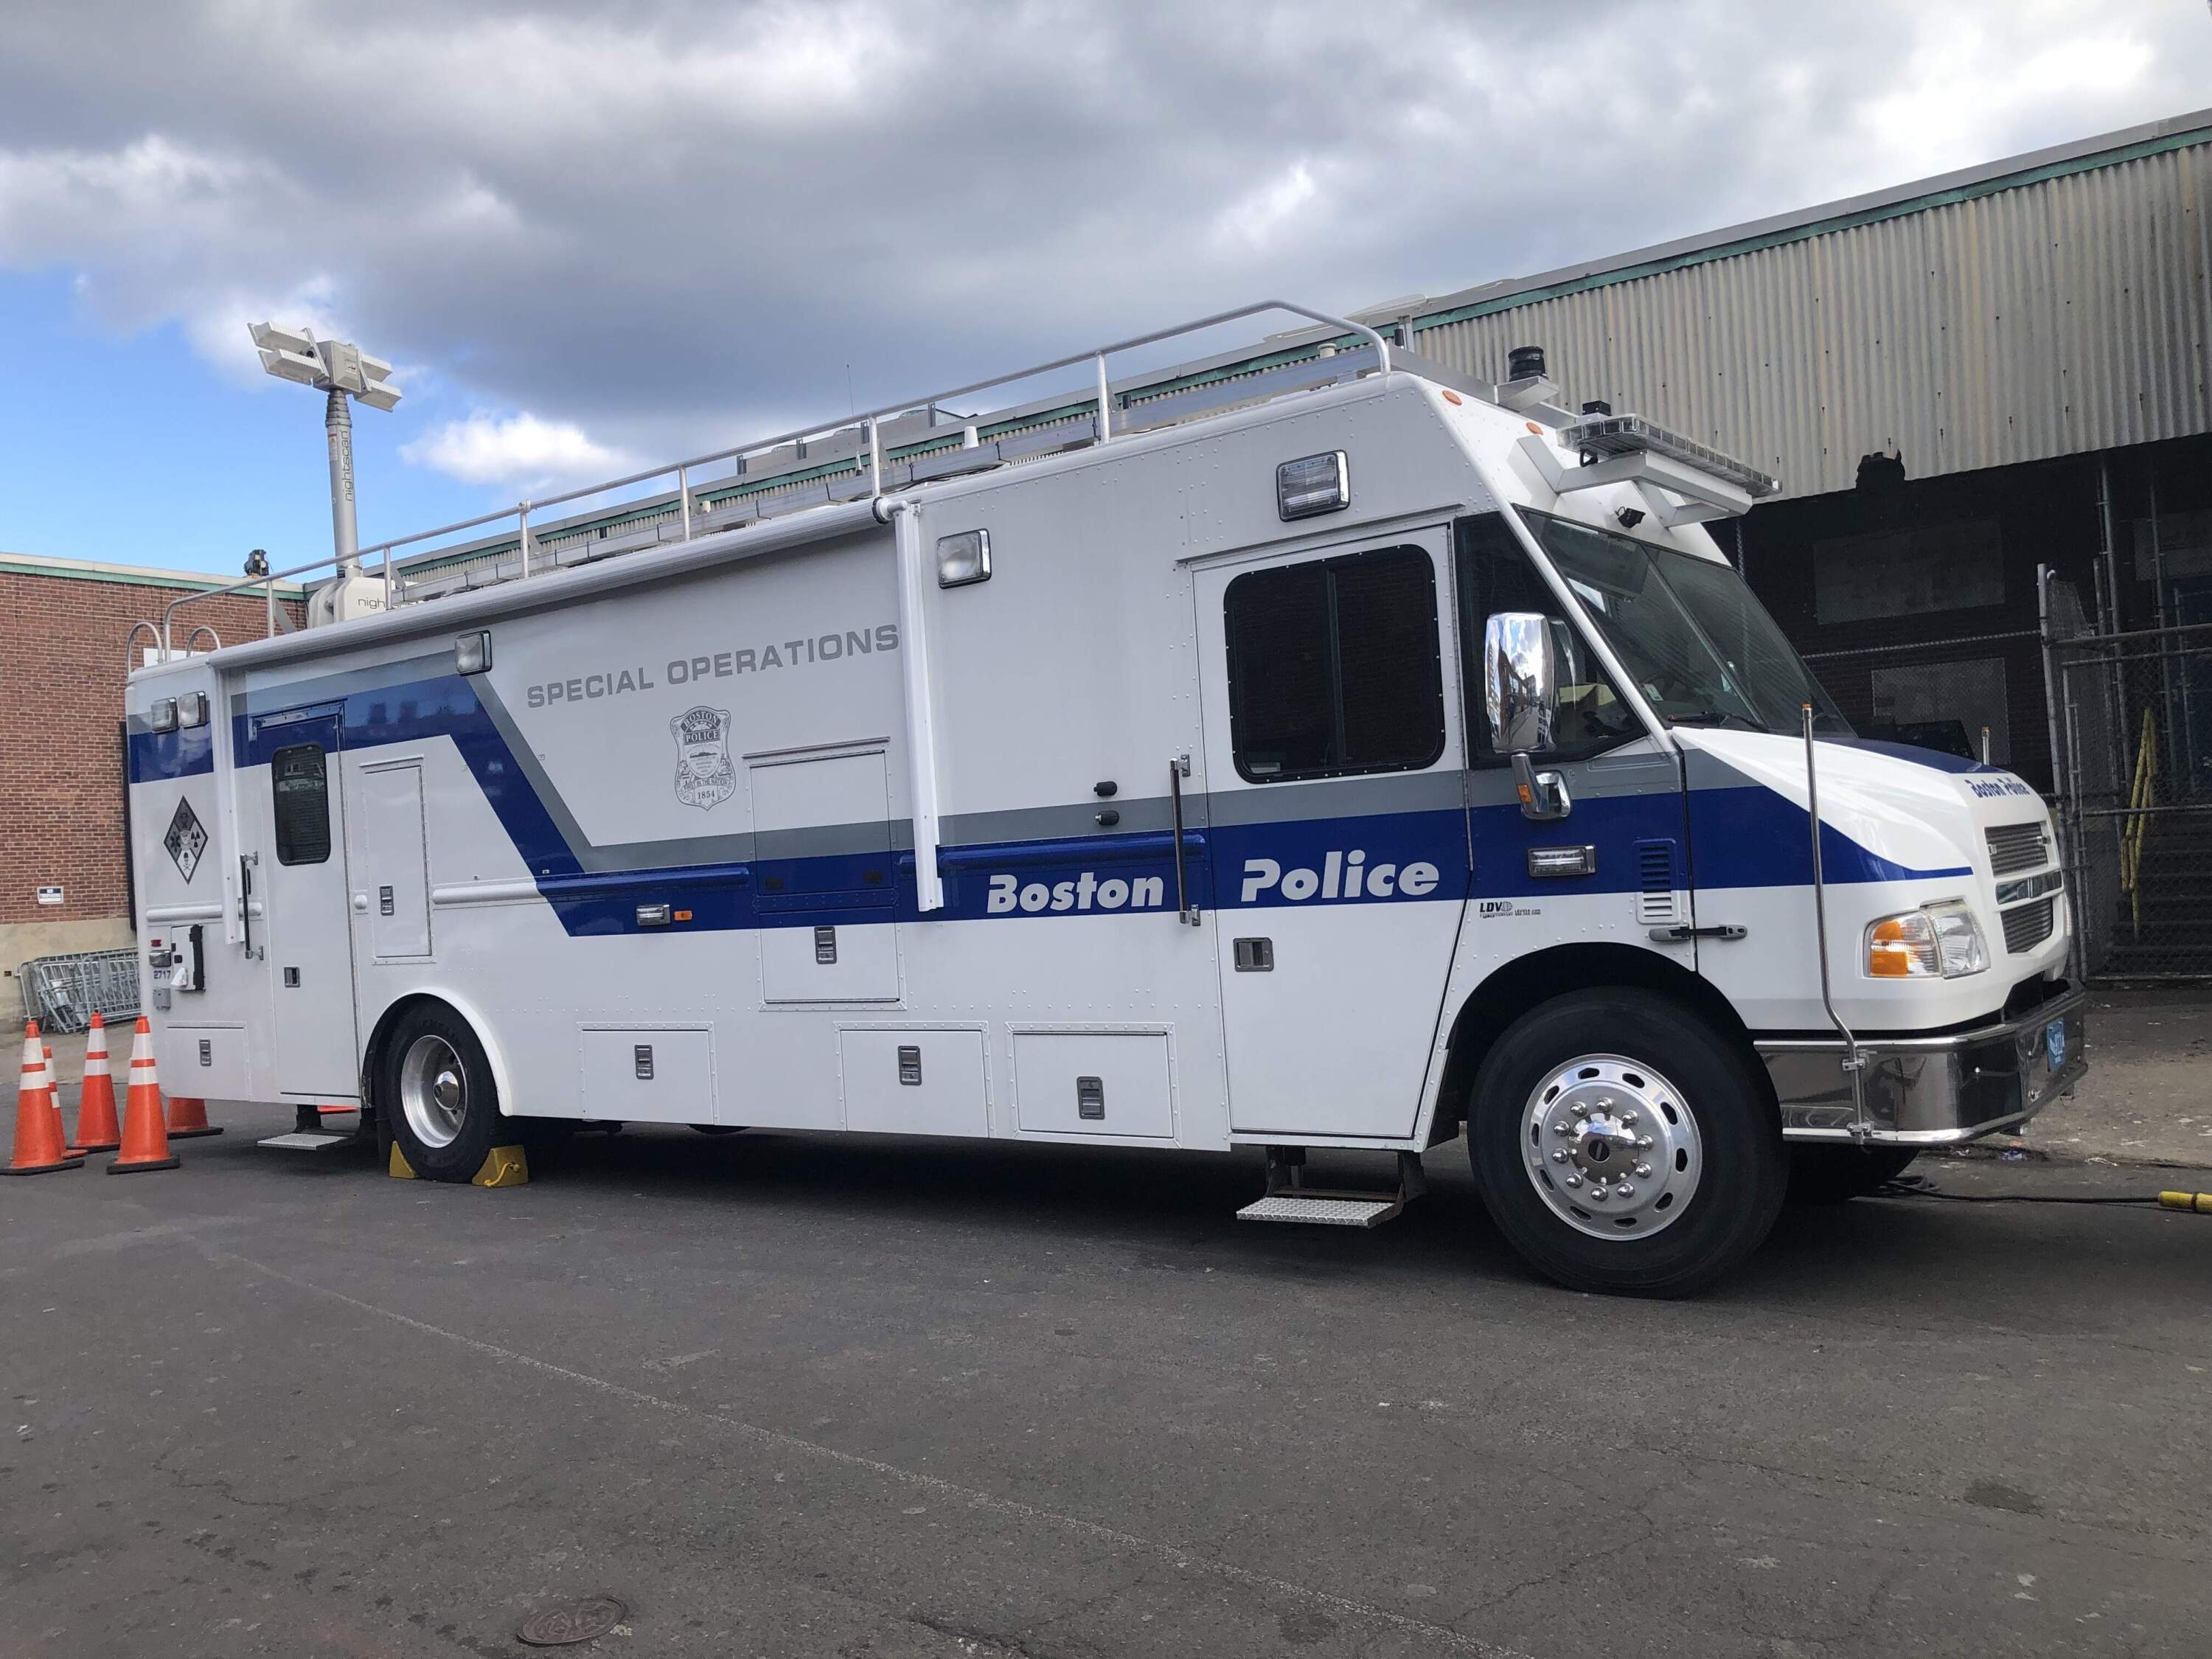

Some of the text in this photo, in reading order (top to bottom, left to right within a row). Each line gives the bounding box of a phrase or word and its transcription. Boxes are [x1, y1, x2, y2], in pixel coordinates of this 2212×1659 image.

[341, 431, 353, 501] nightscan
[527, 624, 899, 709] SPECIAL OPERATIONS
[684, 711, 719, 728] BOSTON
[686, 731, 719, 742] POLICE
[698, 790, 715, 799] 1854
[1964, 779, 2006, 798] Boston
[987, 849, 1440, 914] Boston Police
[1480, 902, 1503, 913] LDV
[153, 970, 171, 979] 2717
